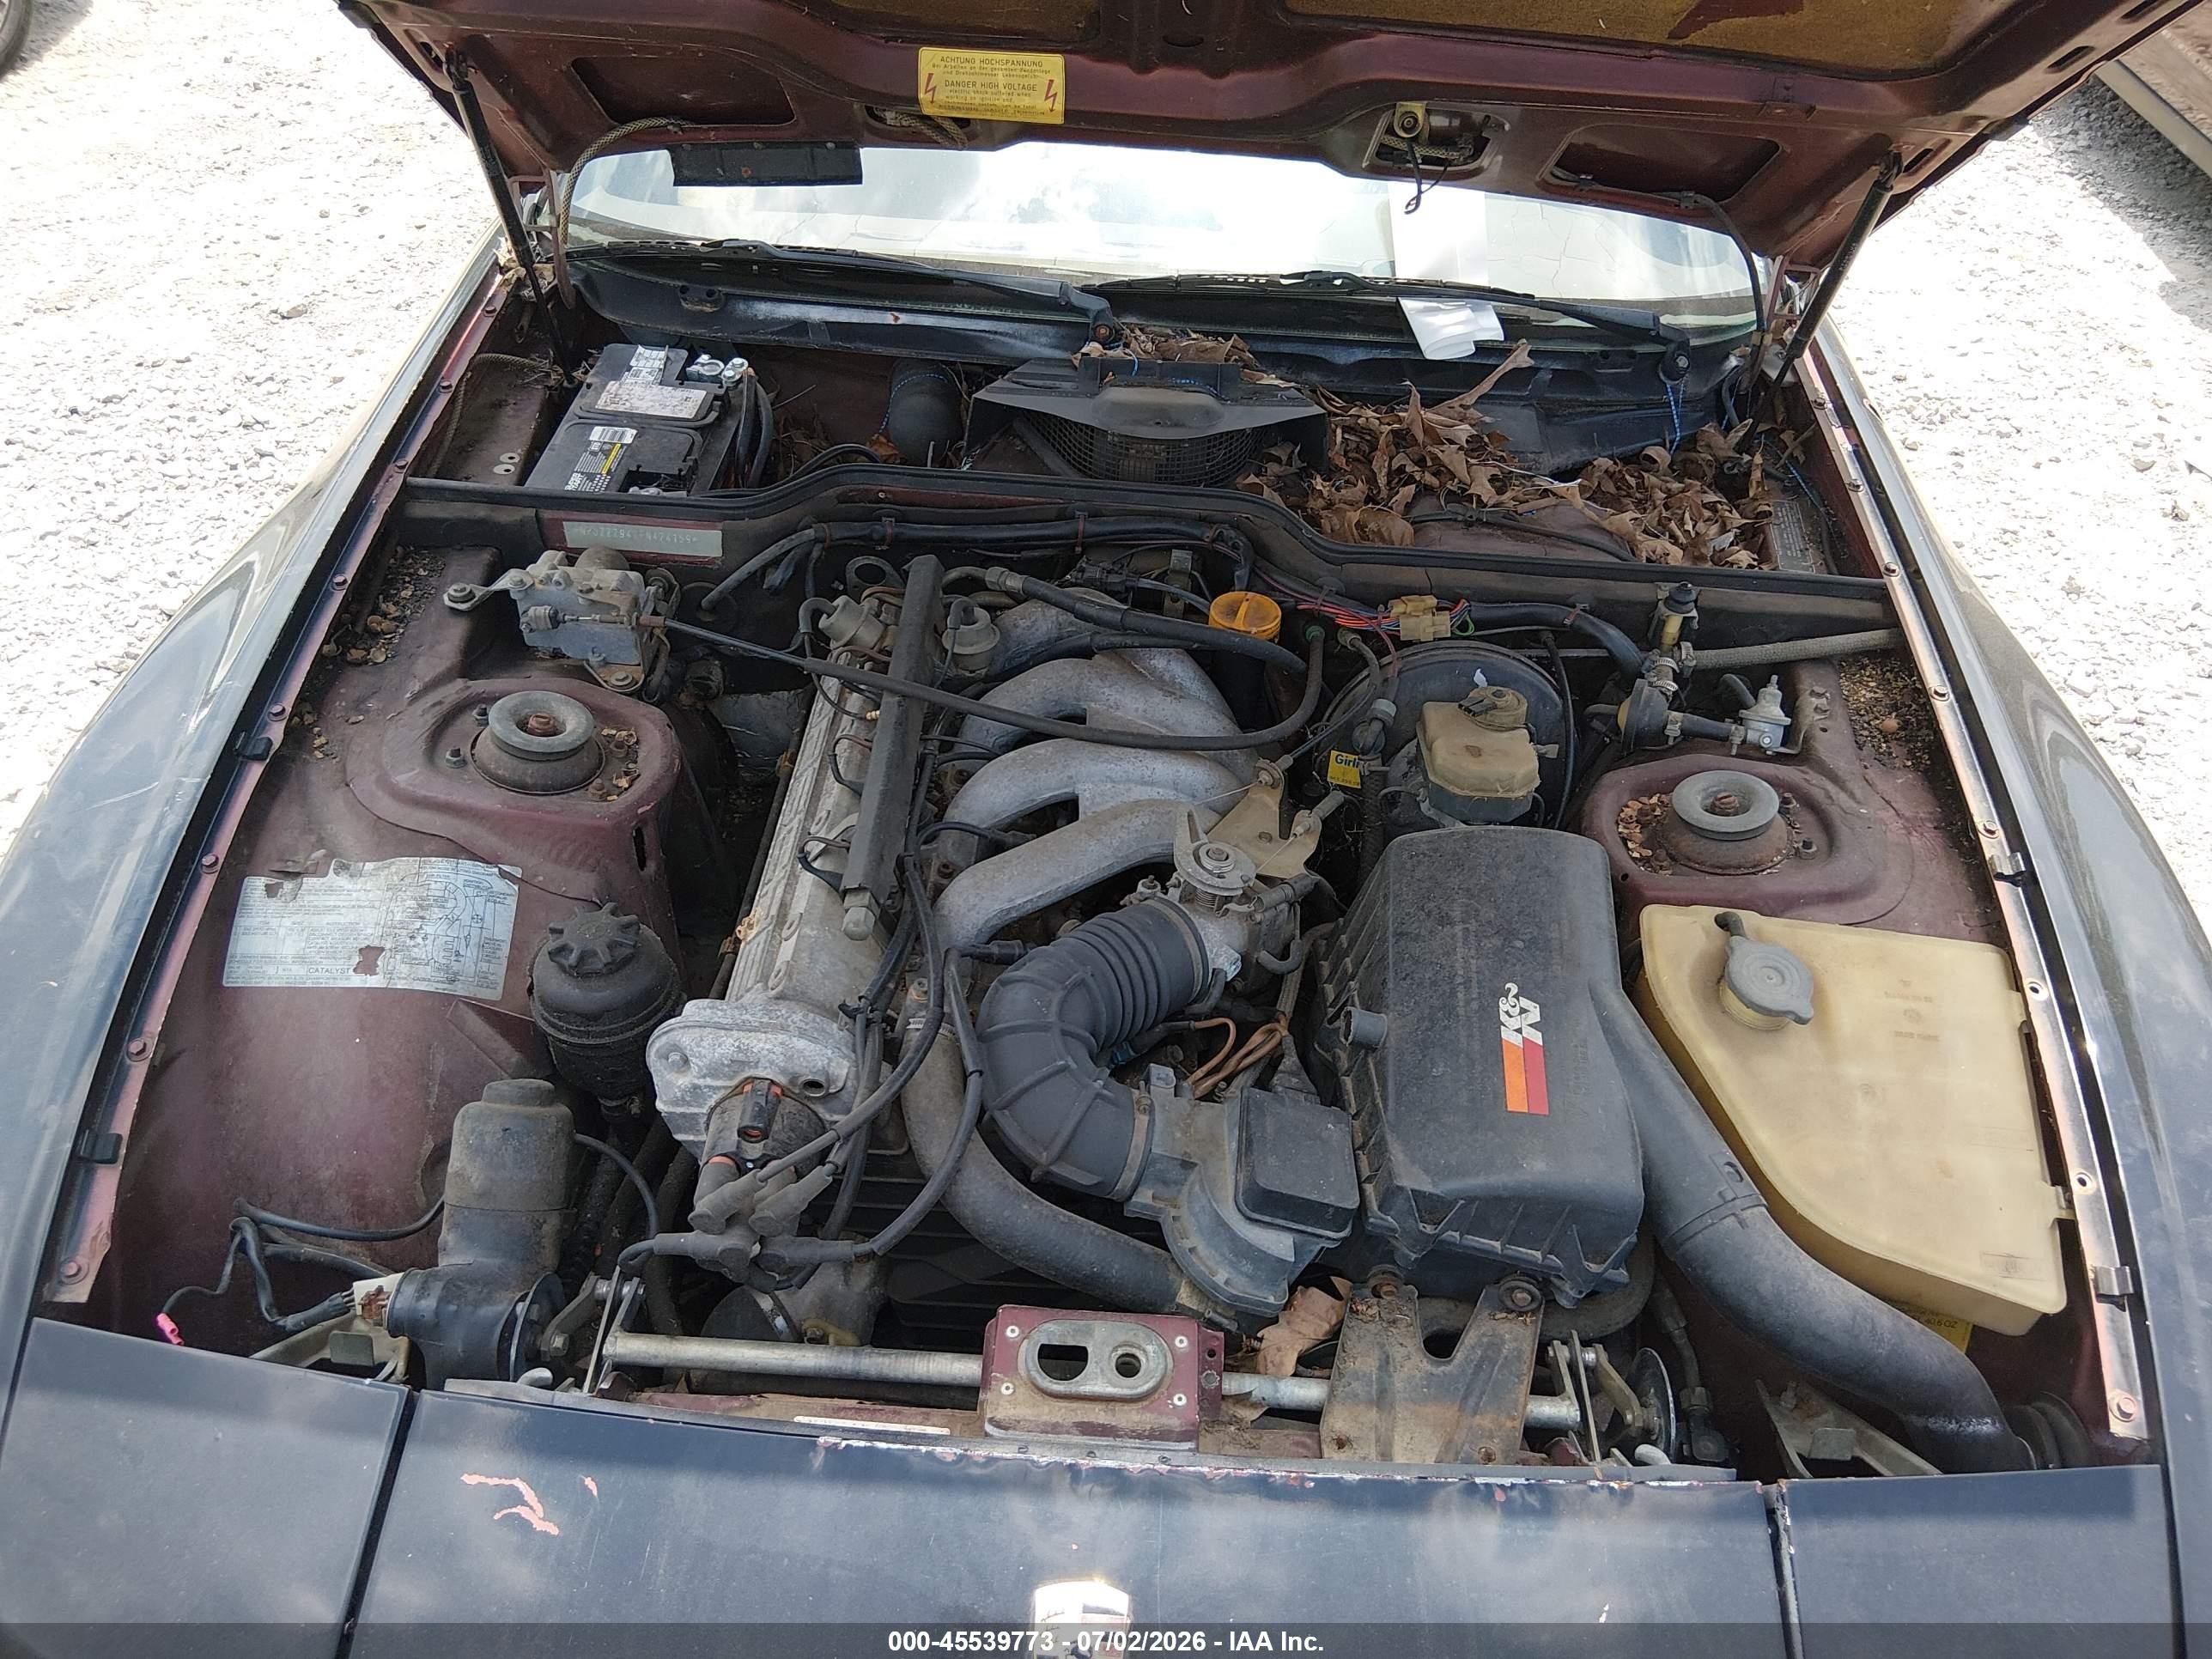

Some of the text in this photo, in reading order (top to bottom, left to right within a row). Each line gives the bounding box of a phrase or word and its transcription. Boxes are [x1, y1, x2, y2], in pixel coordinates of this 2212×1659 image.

[940, 56, 1043, 68] ACHTUNG HOCHSPANNUNG
[944, 79, 1038, 92] DANGER HIGH VOLTAGE
